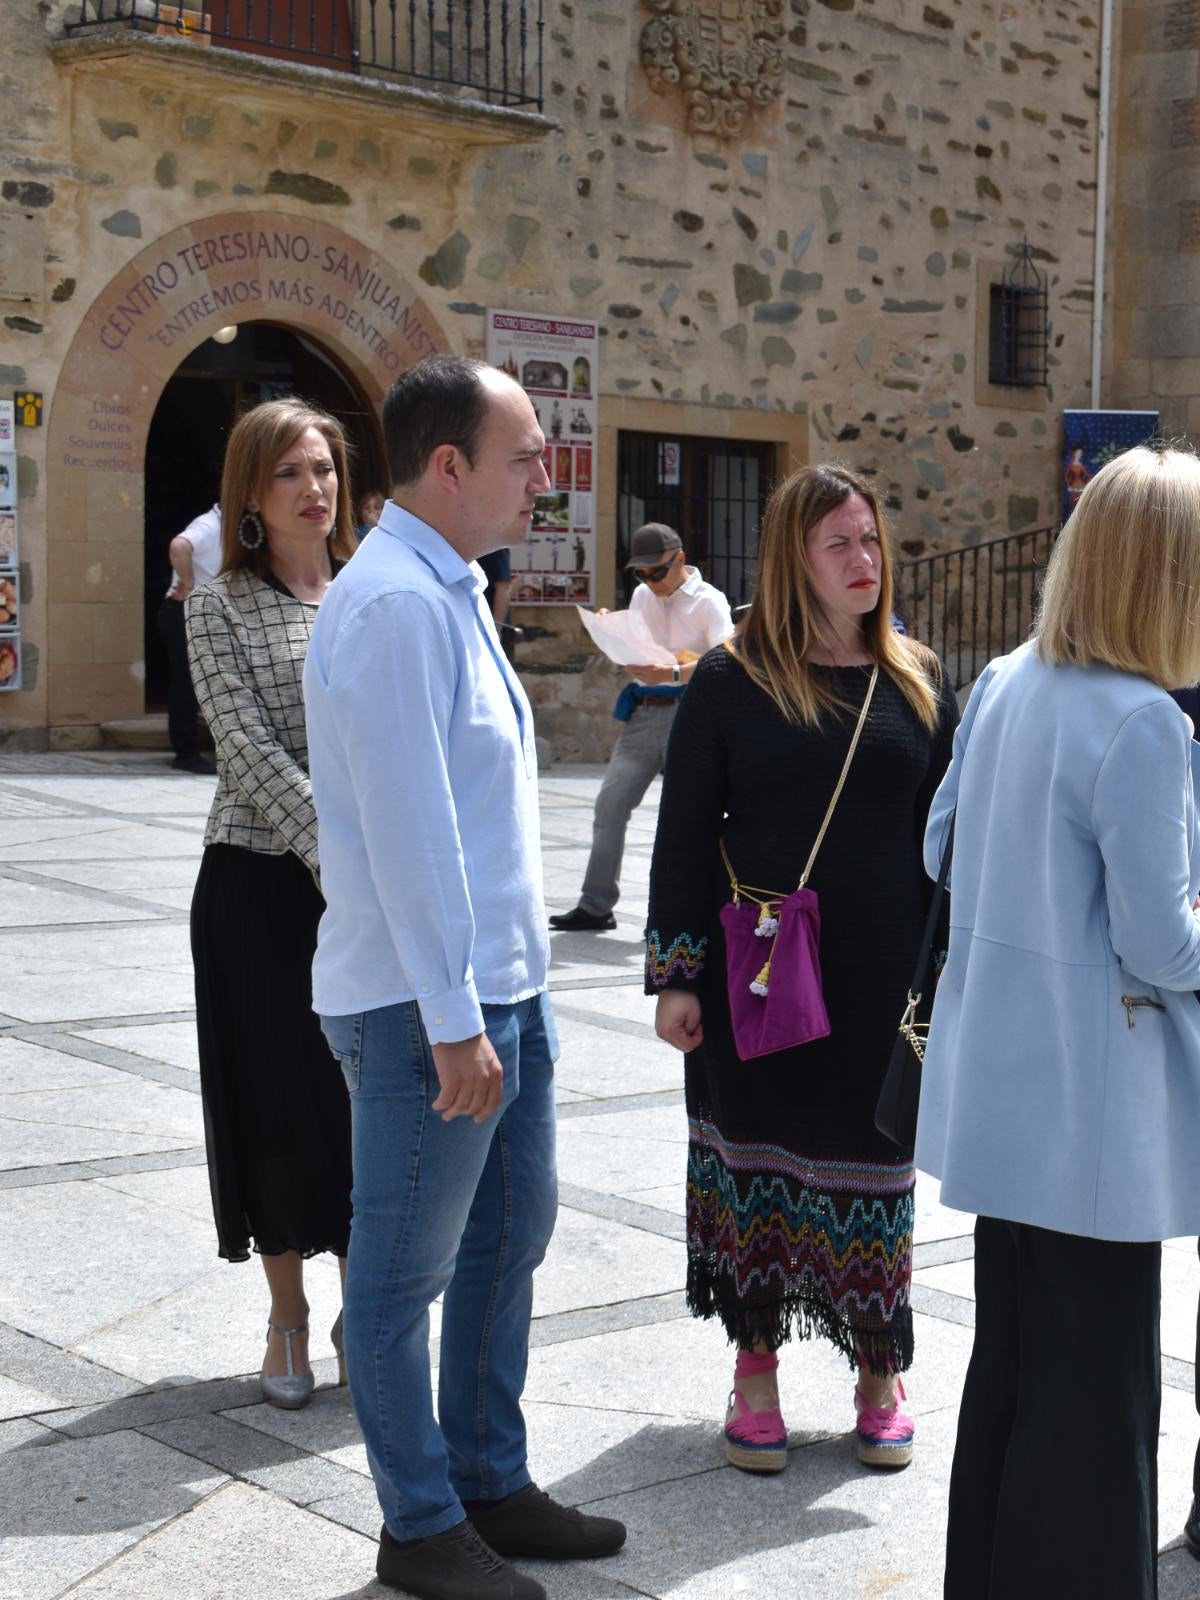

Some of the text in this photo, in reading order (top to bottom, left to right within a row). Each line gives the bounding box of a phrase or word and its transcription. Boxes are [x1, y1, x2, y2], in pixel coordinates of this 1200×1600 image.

[267, 278, 315, 306] MÁS
[99, 260, 179, 351] CENTRO
[92, 400, 132, 415] Libros
[88, 418, 132, 432] Dulces
[68, 435, 132, 450] Souvenirs
